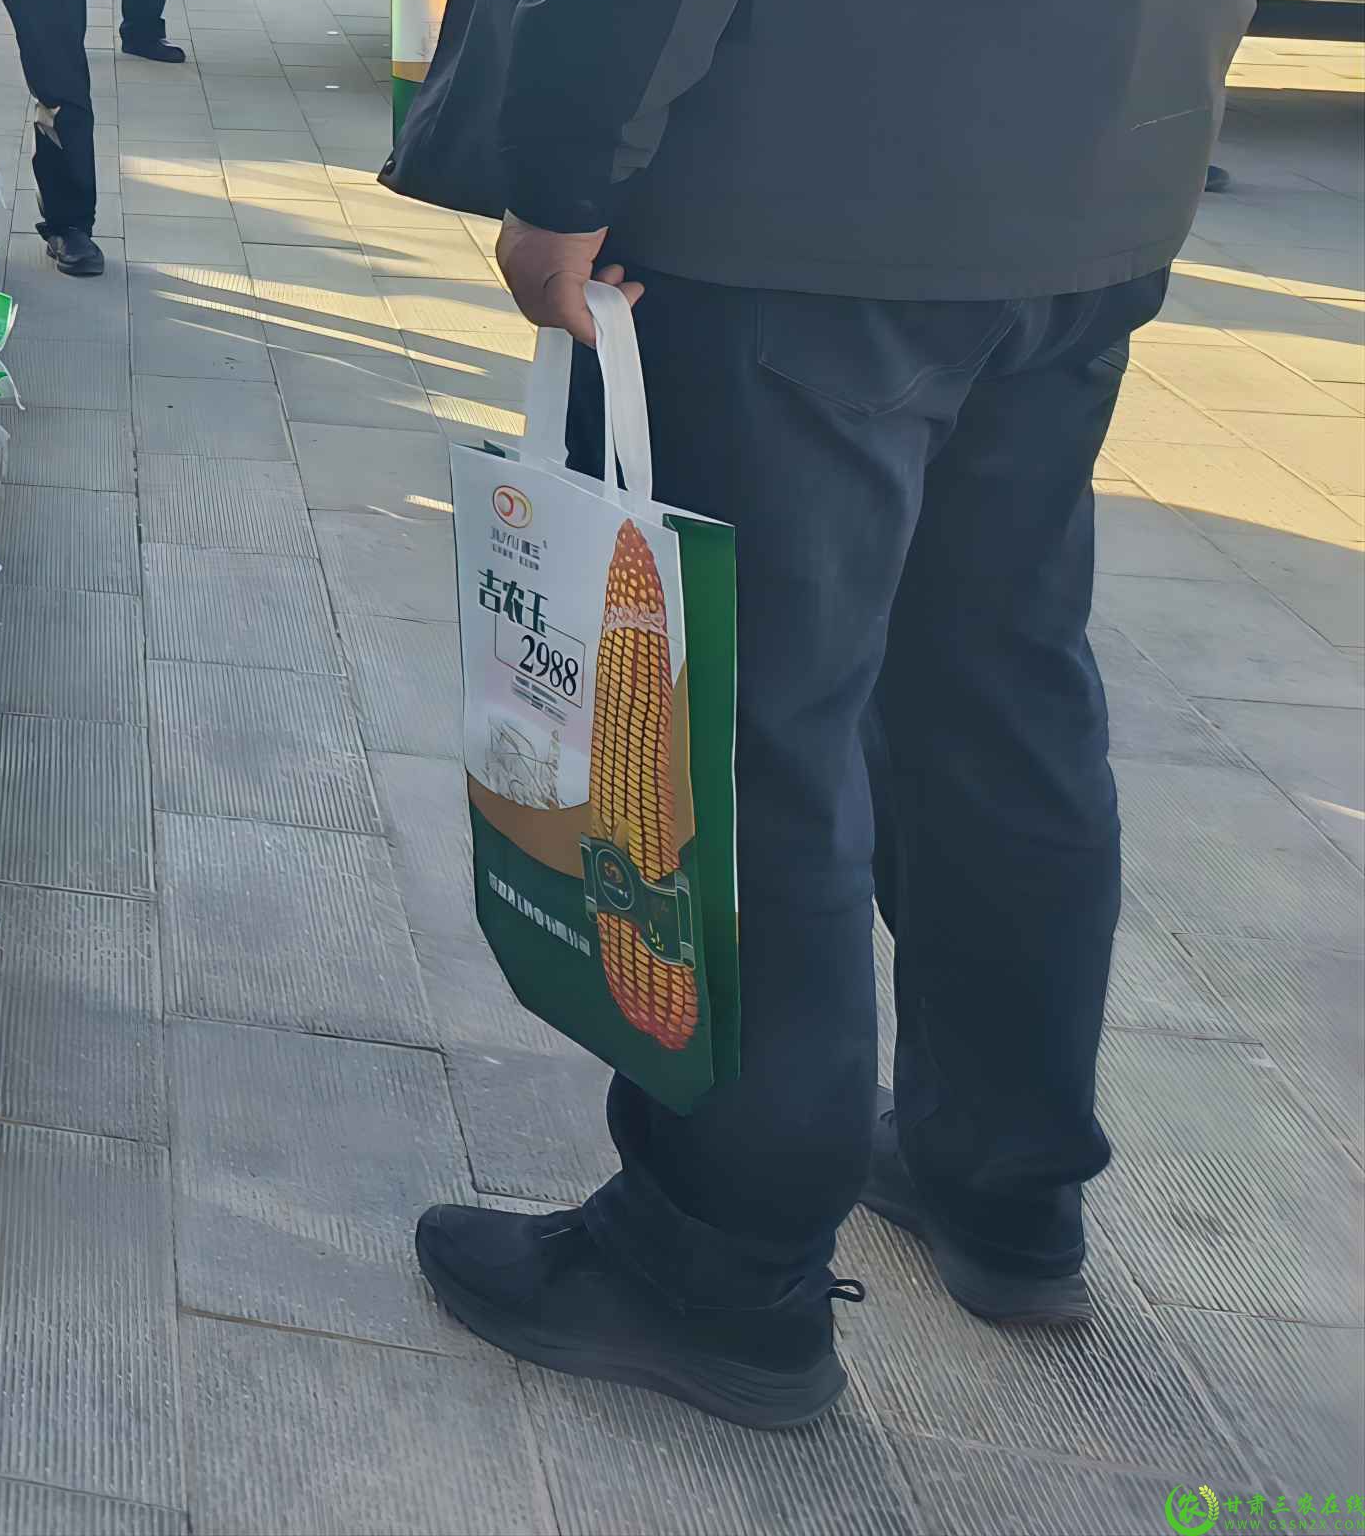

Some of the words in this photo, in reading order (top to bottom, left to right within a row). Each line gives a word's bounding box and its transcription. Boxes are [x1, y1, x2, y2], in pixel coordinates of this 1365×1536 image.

[477, 568, 549, 639] 吉农玉
[519, 634, 579, 697] 2988
